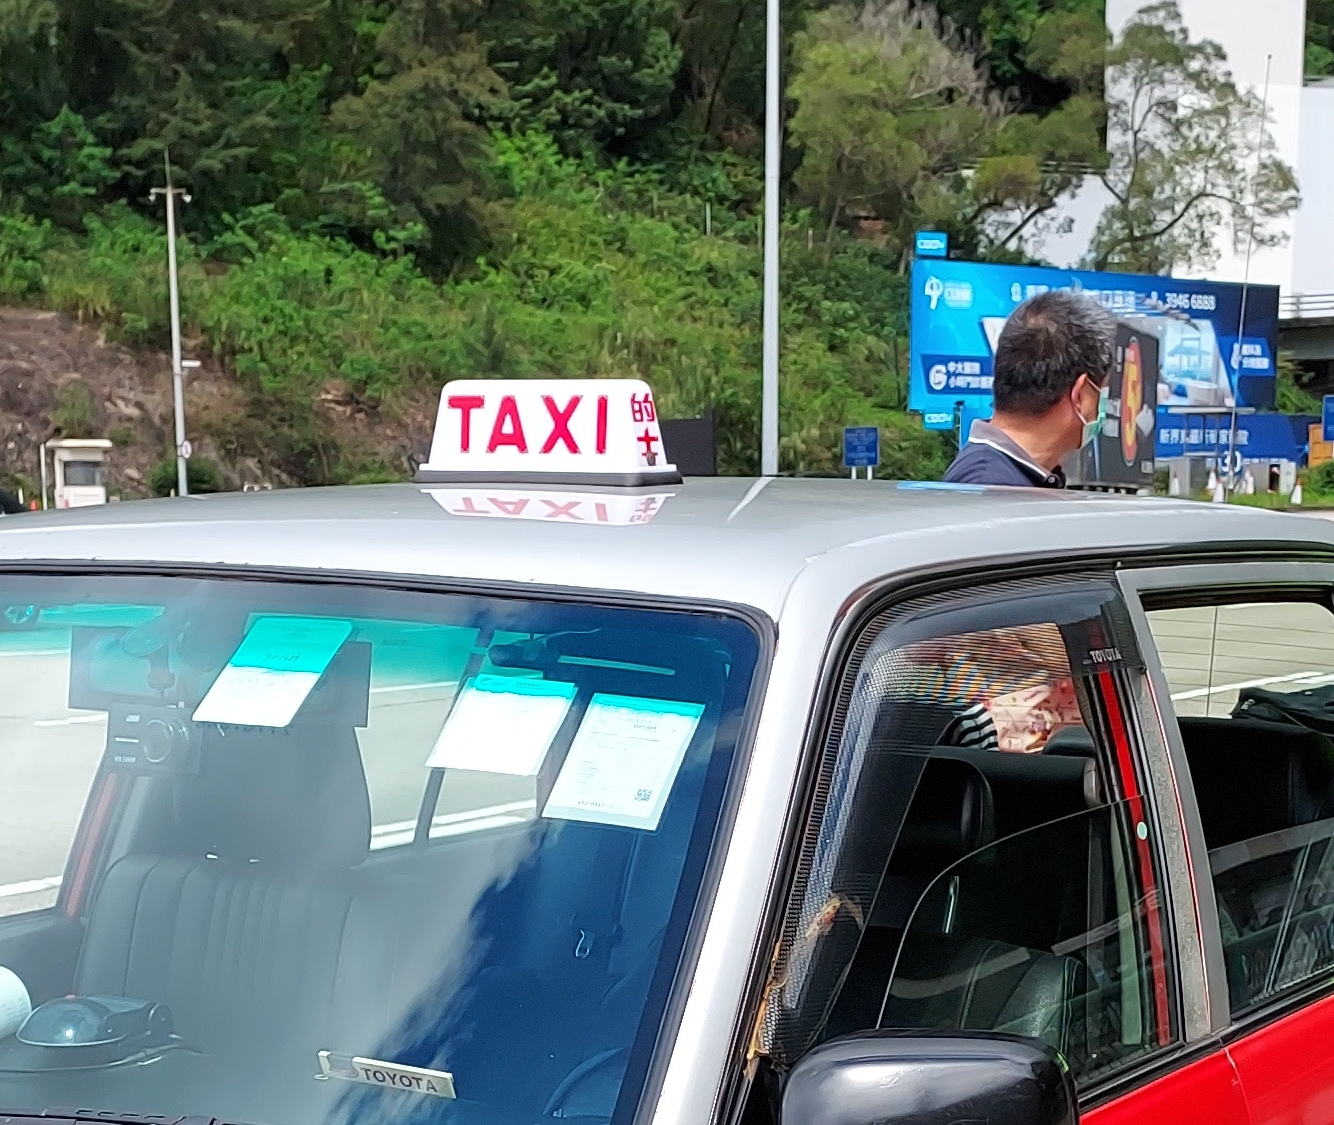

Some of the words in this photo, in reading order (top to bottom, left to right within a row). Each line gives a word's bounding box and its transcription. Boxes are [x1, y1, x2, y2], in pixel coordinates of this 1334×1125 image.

[447, 394, 609, 454] TAXI
[630, 393, 659, 466] 的士
[1089, 648, 1123, 663] TOYOTA
[360, 1067, 438, 1093] TOYOTA
